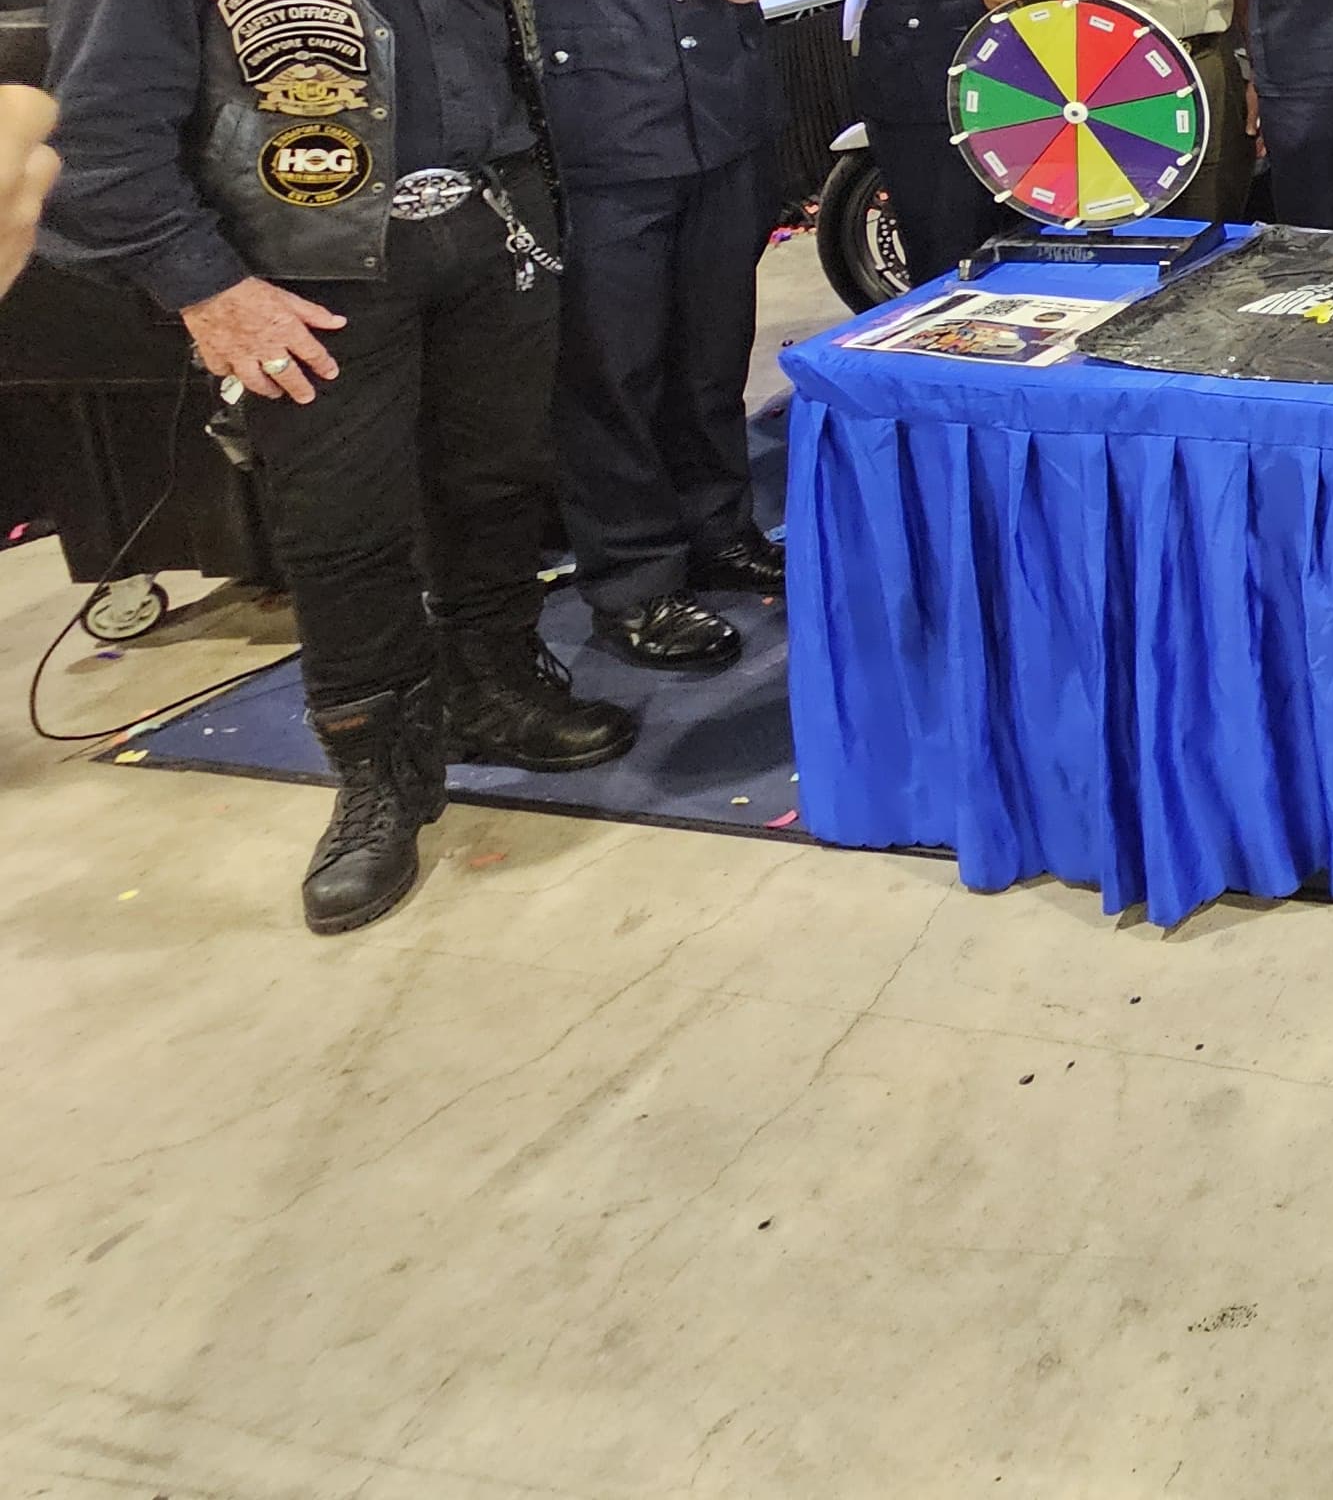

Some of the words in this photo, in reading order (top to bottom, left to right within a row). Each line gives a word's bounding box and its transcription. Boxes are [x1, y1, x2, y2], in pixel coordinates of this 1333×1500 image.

[239, 9, 287, 38] SAFETY
[288, 6, 349, 24] OFFICER
[247, 38, 303, 66] SINGAPORE
[307, 37, 358, 57] CHAPTER
[278, 148, 352, 172] HOG
